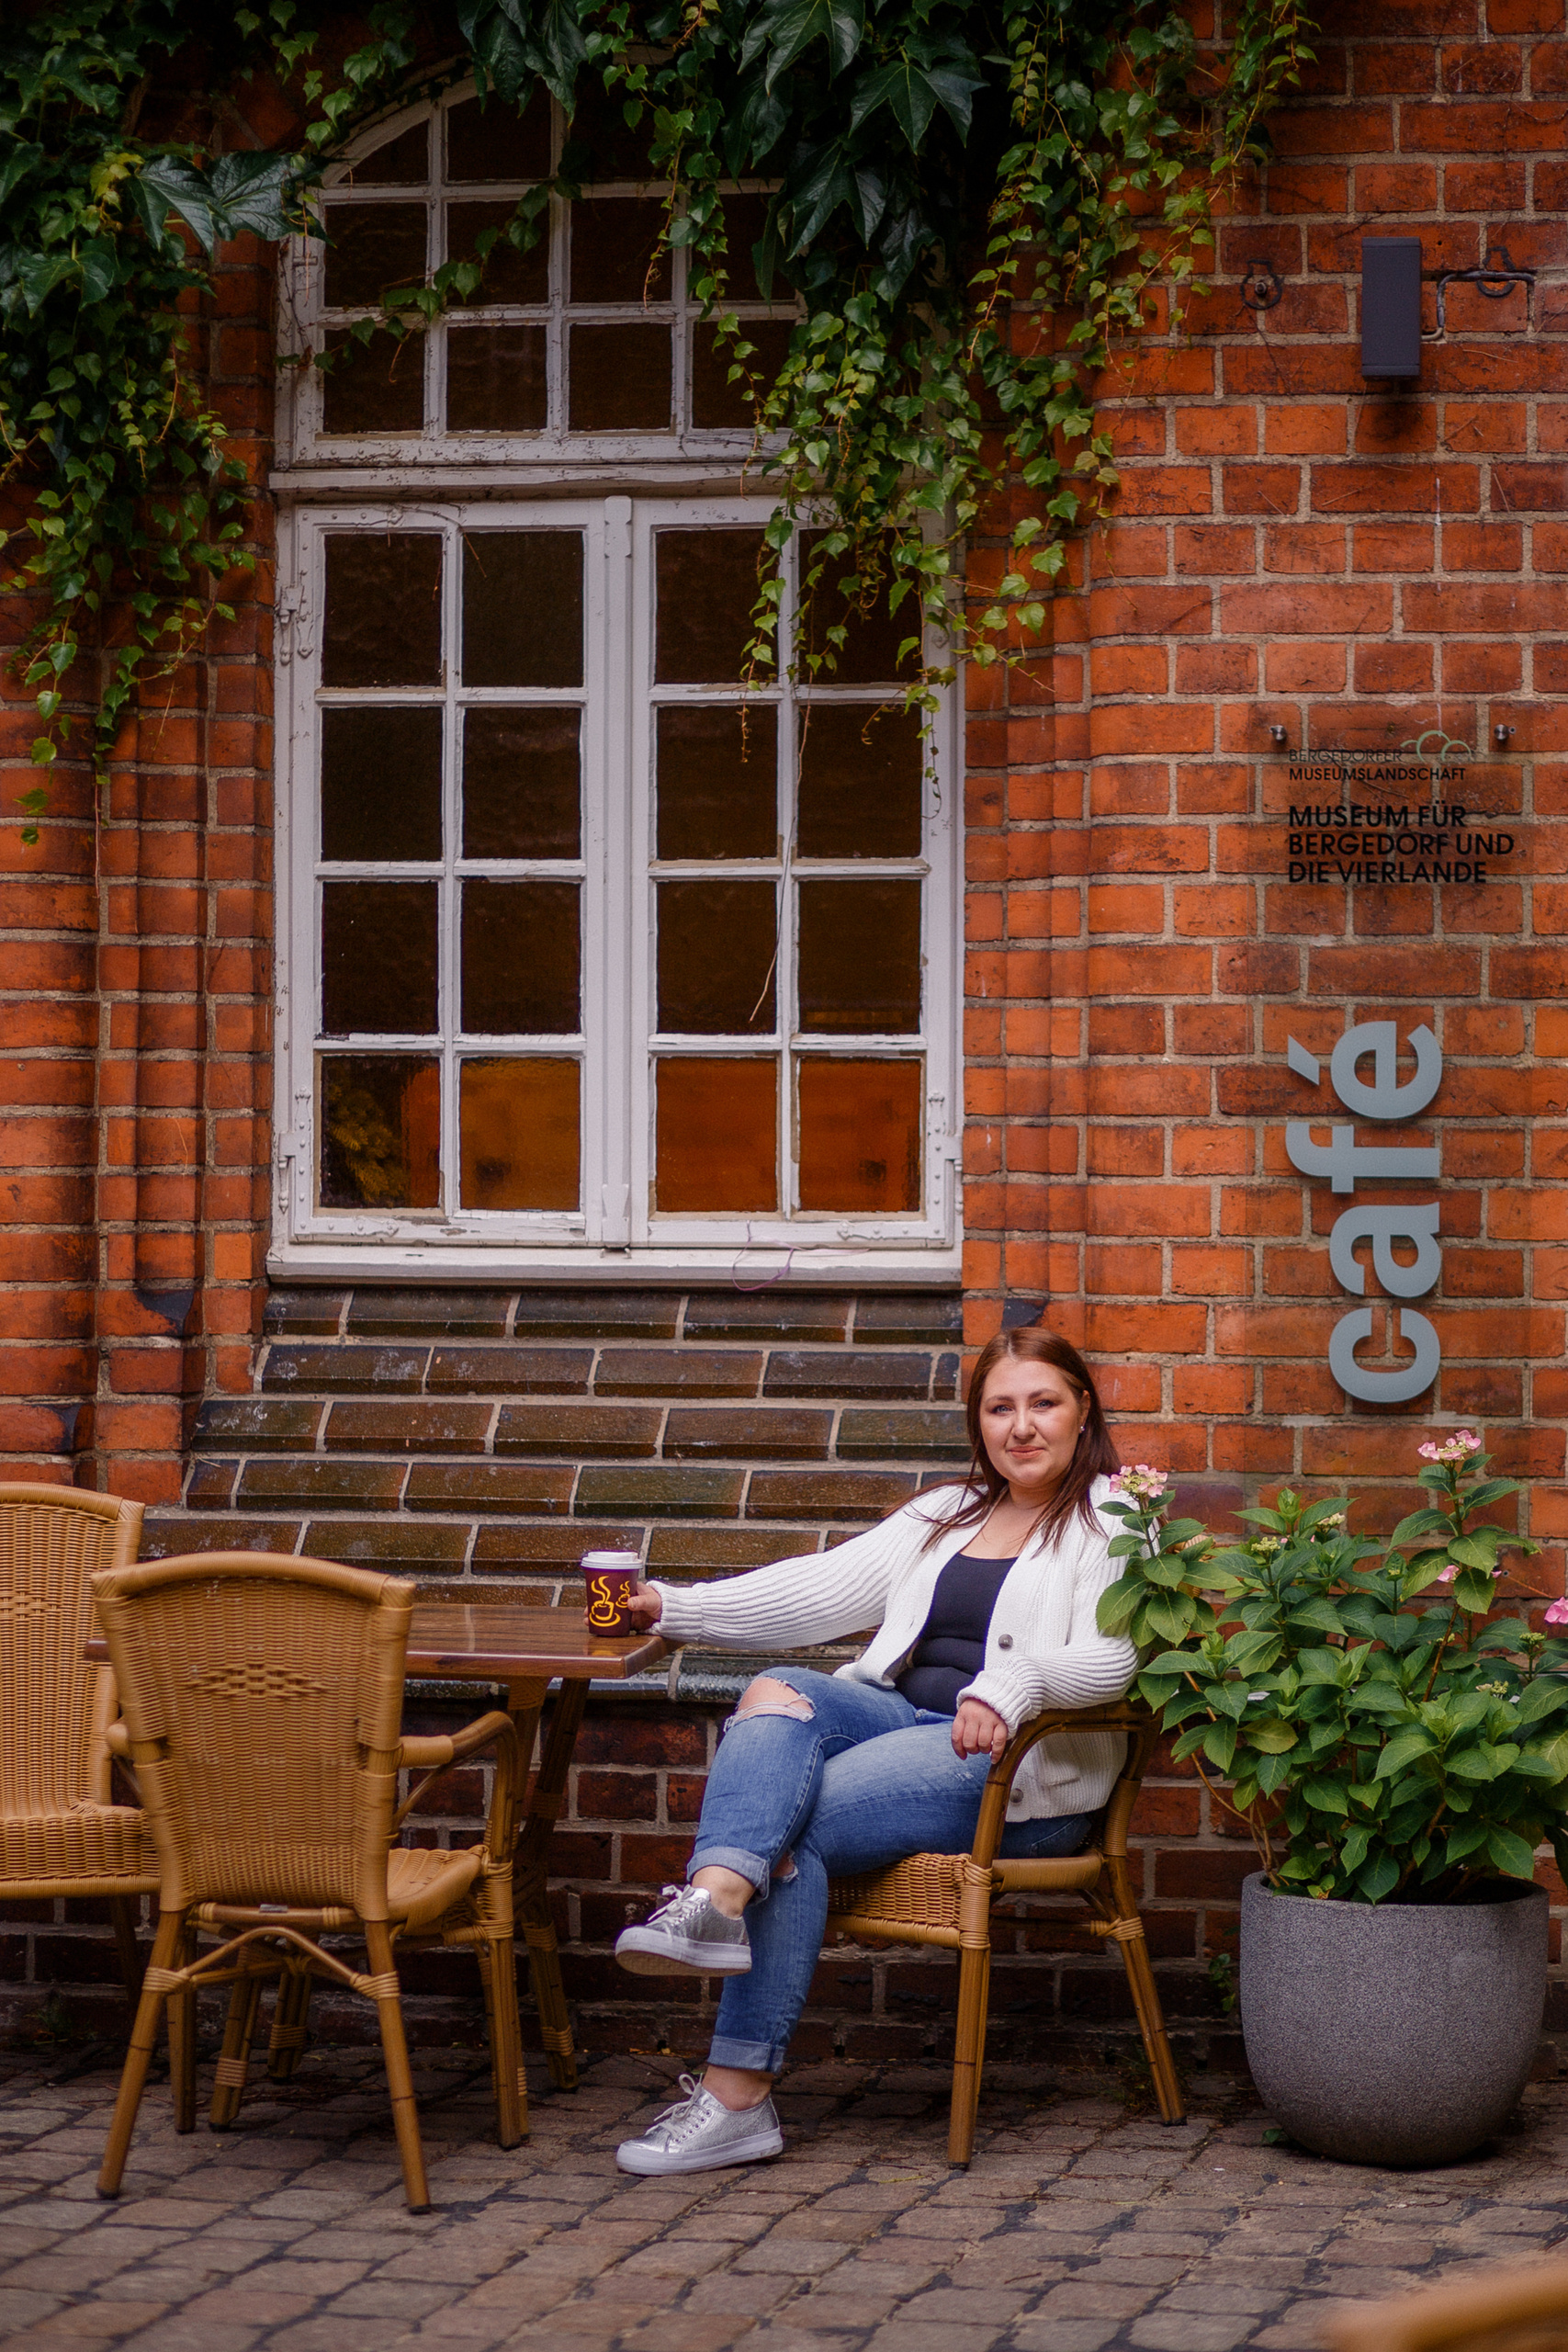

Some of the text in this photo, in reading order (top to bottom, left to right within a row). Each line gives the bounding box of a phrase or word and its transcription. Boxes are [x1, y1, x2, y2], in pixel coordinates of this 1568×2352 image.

[1289, 749, 1403, 763] BERGEDORFER
[1289, 767, 1466, 781] MUSEUMSLANDSCHAFT
[1289, 800, 1466, 827] MUSEUM FÜR
[1289, 833, 1515, 855] BERGEDORF UND
[1289, 862, 1486, 883] DIE VIERLANDE
[1286, 1020, 1442, 1403] café
